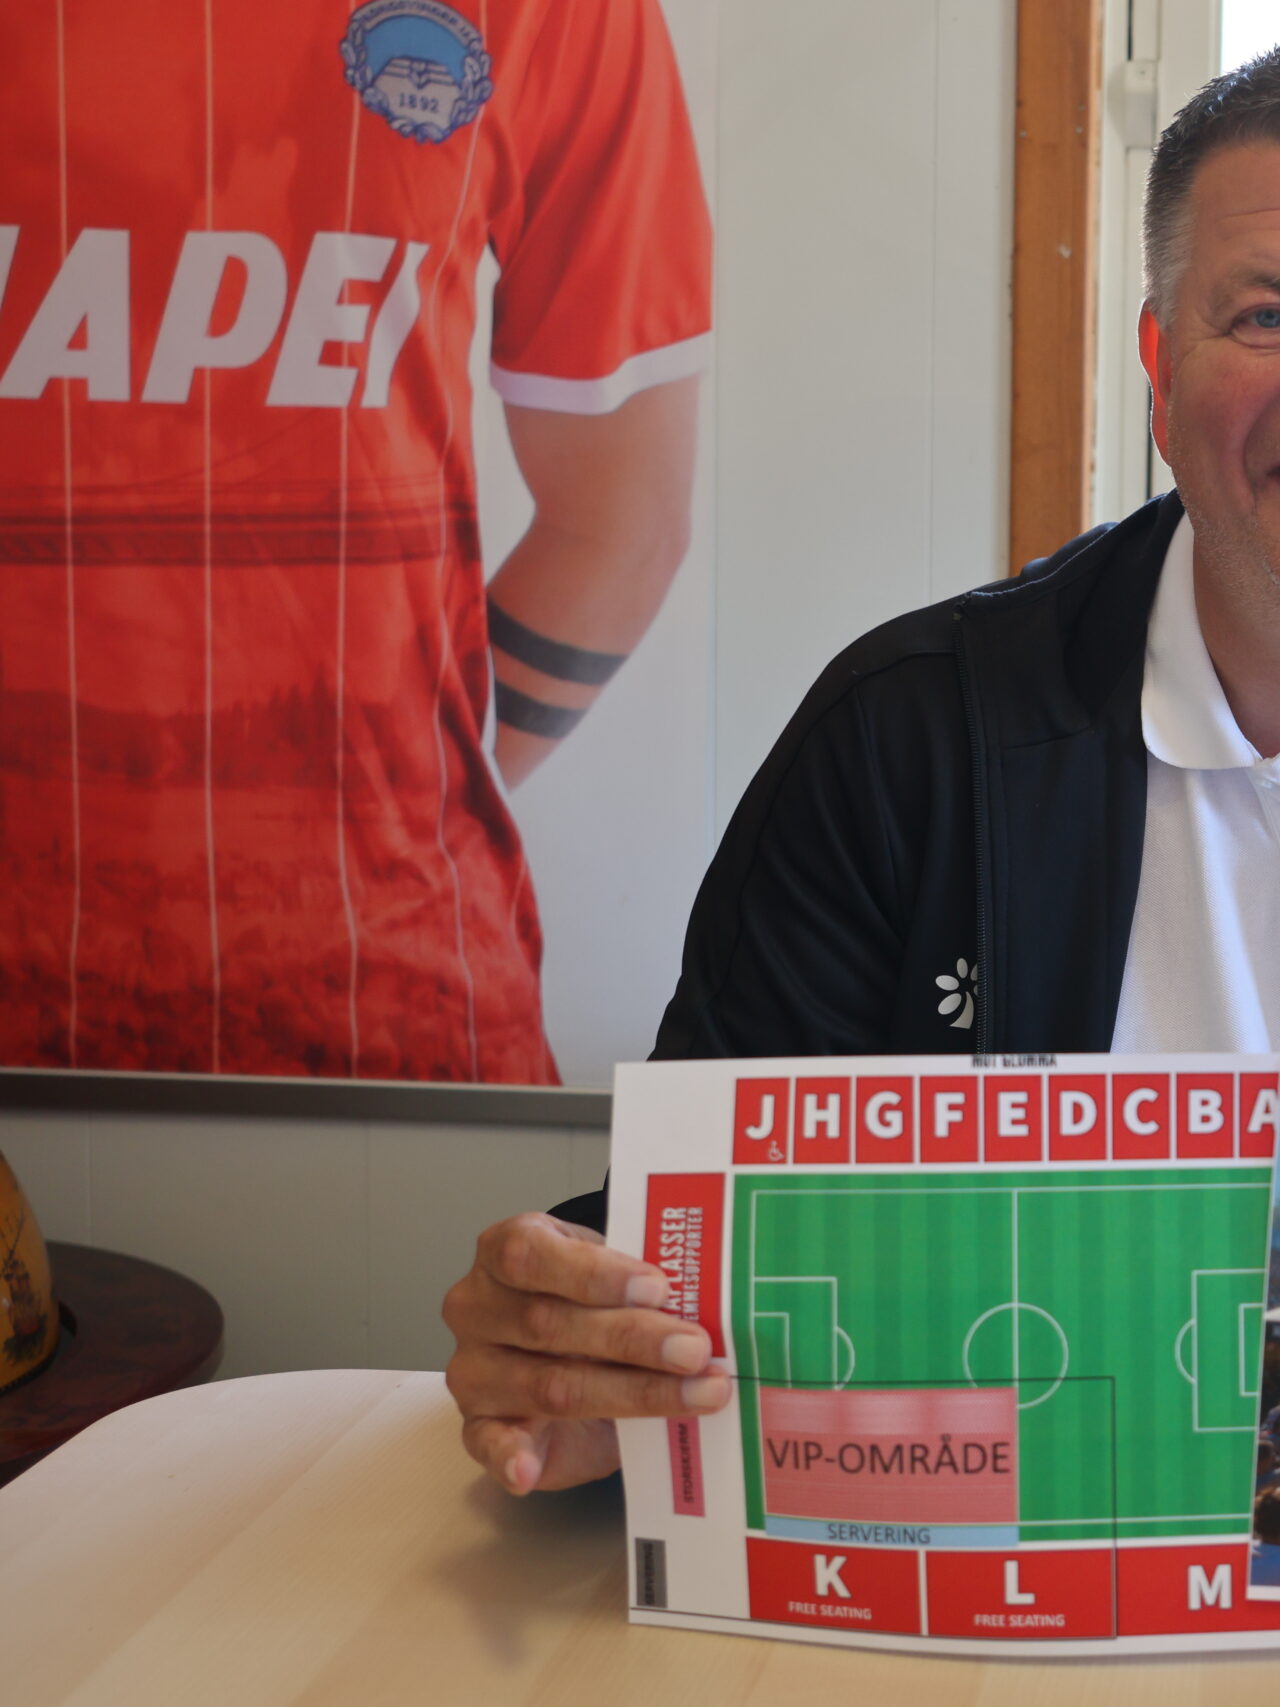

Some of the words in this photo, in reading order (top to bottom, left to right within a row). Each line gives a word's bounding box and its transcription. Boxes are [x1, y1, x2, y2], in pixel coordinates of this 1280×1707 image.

[399, 93, 440, 113] 1892
[745, 1094, 775, 1140] J
[803, 1093, 841, 1139] H
[865, 1091, 903, 1139] G
[934, 1092, 965, 1138] F
[997, 1091, 1029, 1137] E
[1059, 1090, 1097, 1136] D
[1123, 1088, 1160, 1135] C
[1187, 1089, 1224, 1134] B
[1247, 1088, 1279, 1134] A
[683, 1207, 704, 1320] EMMESUPPORTER
[766, 1434, 1010, 1475] VIP-OMRÅDE
[827, 1524, 931, 1544] SERVERING
[814, 1554, 851, 1598] K
[1004, 1560, 1035, 1605] L
[1188, 1564, 1232, 1610] M
[788, 1601, 817, 1615] FREE
[819, 1604, 873, 1620] SEATING
[974, 1614, 1004, 1628] FREE
[1007, 1614, 1066, 1628] SEATING
